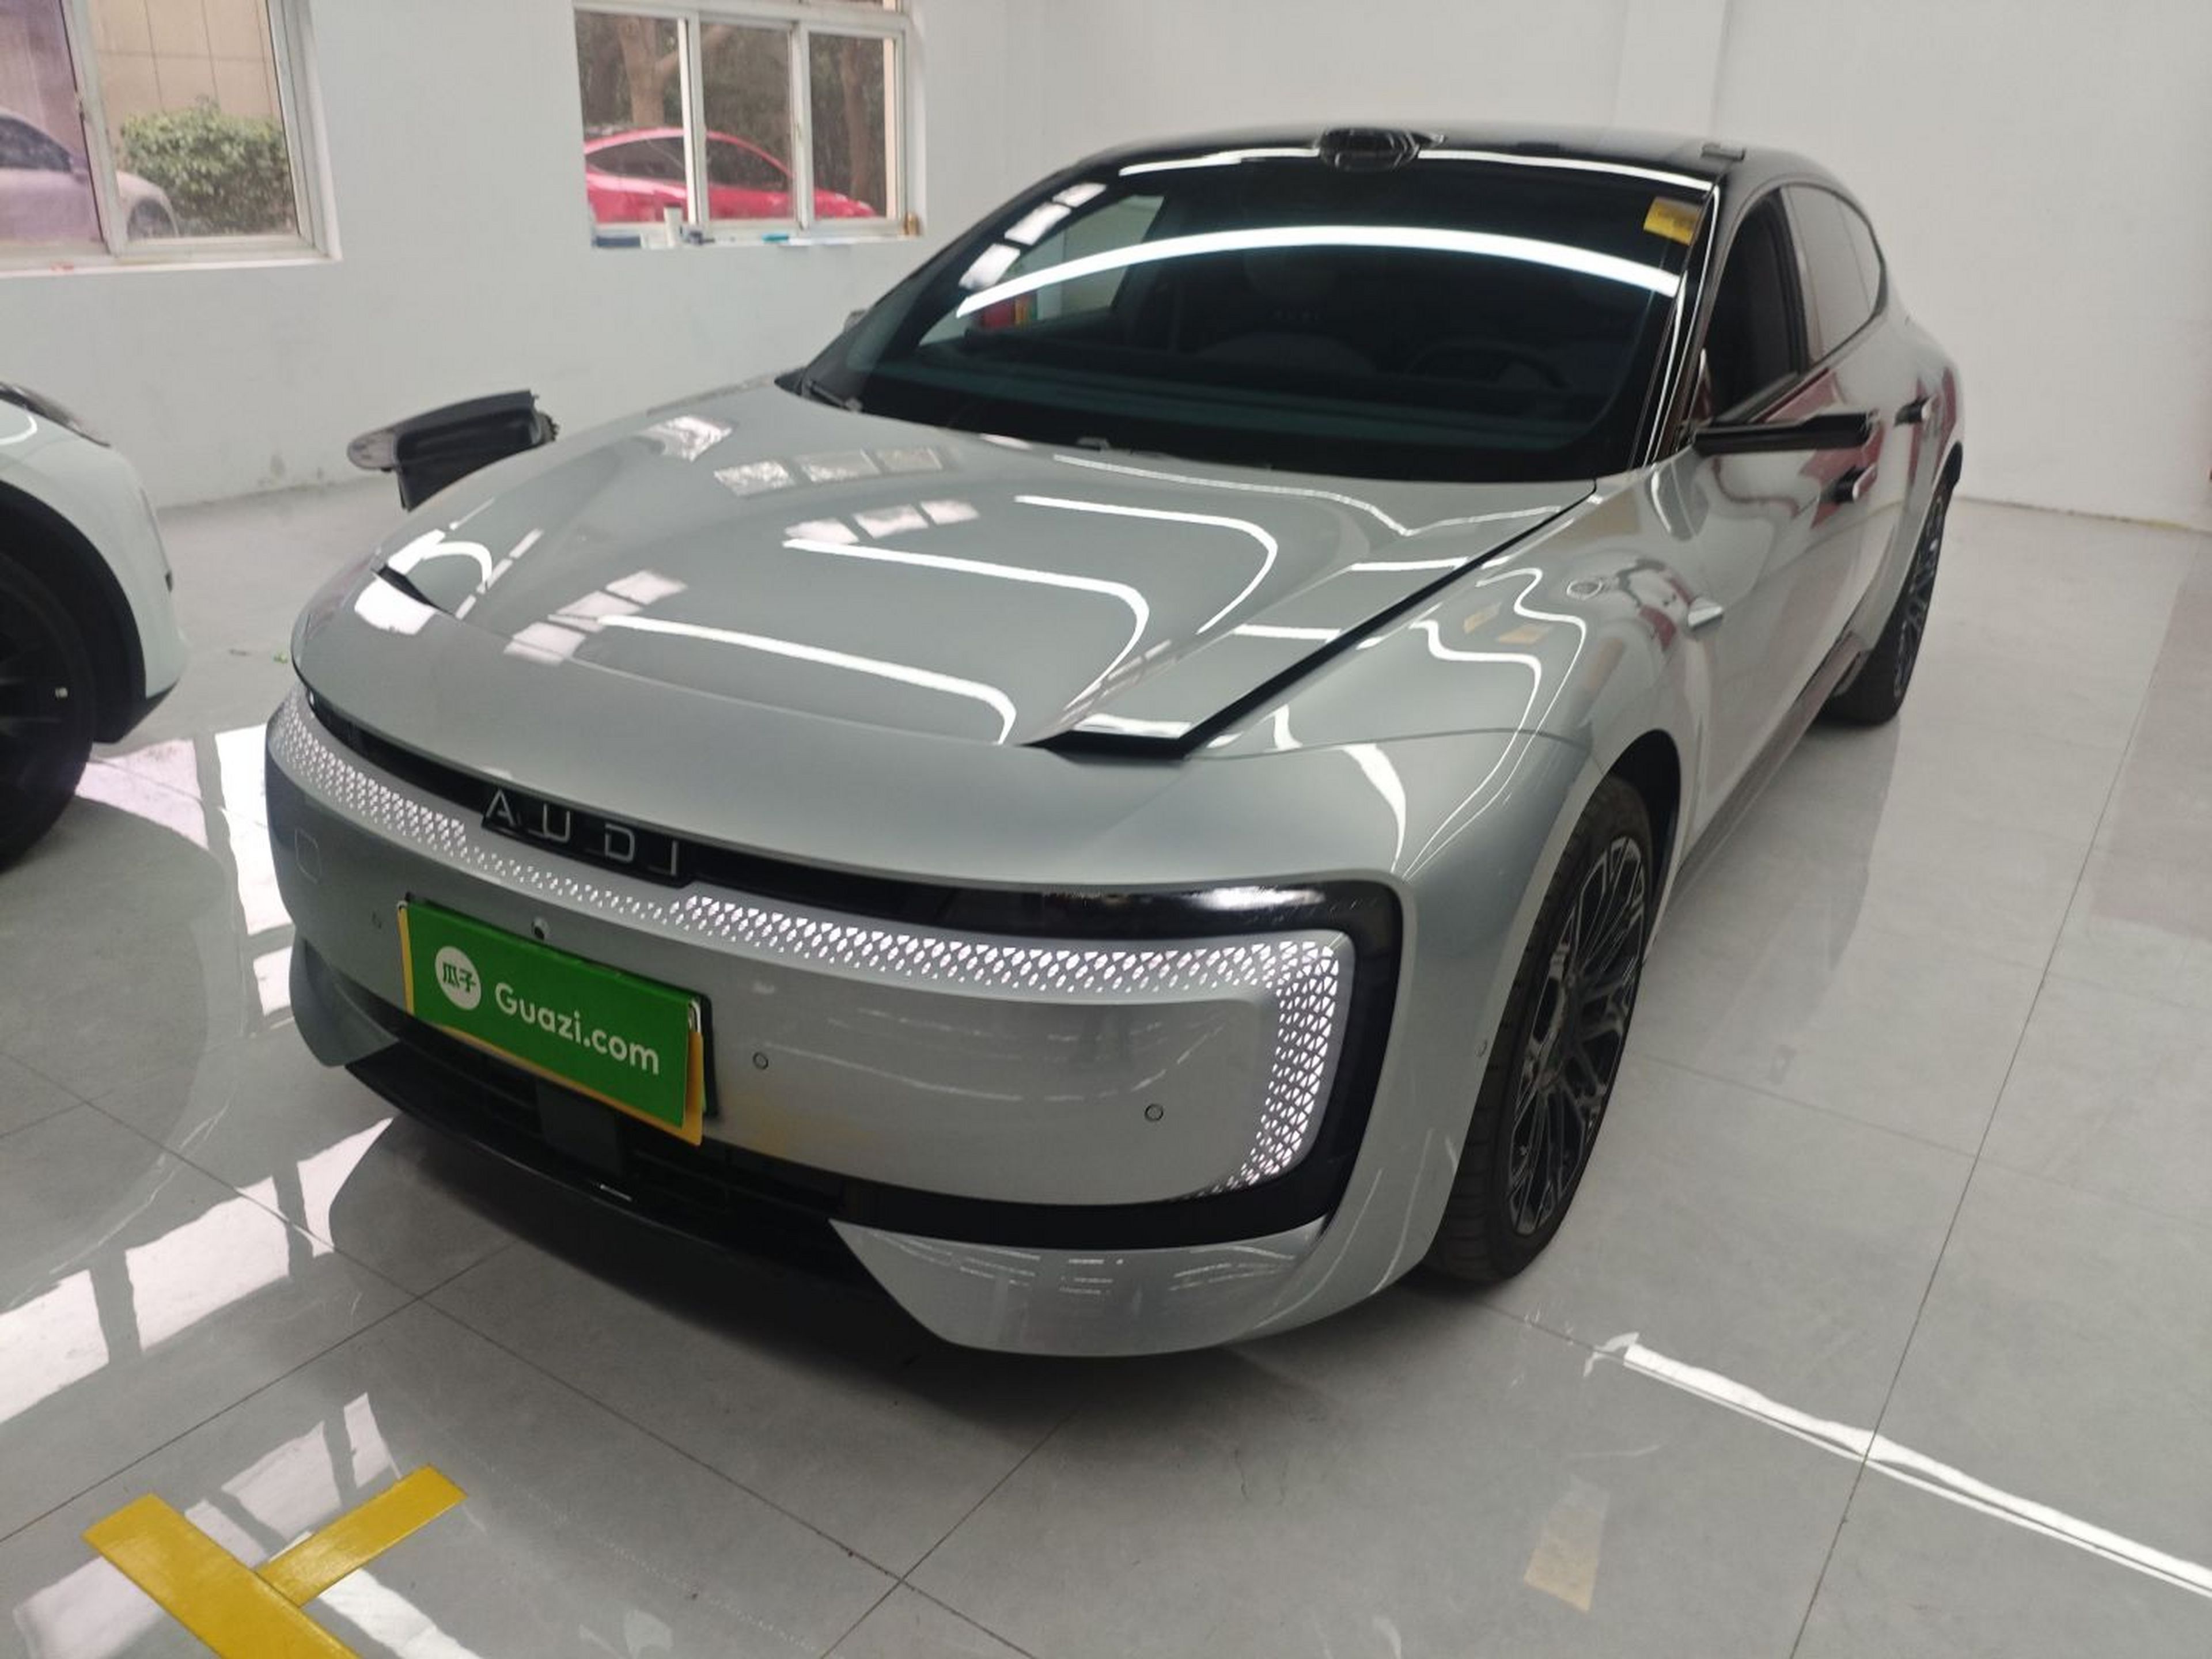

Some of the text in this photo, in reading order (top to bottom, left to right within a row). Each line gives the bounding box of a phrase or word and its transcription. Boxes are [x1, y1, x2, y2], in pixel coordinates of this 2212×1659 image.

[485, 789, 680, 876] AUDI
[442, 963, 476, 993] 瓜子
[495, 982, 660, 1075] Guazi.com
